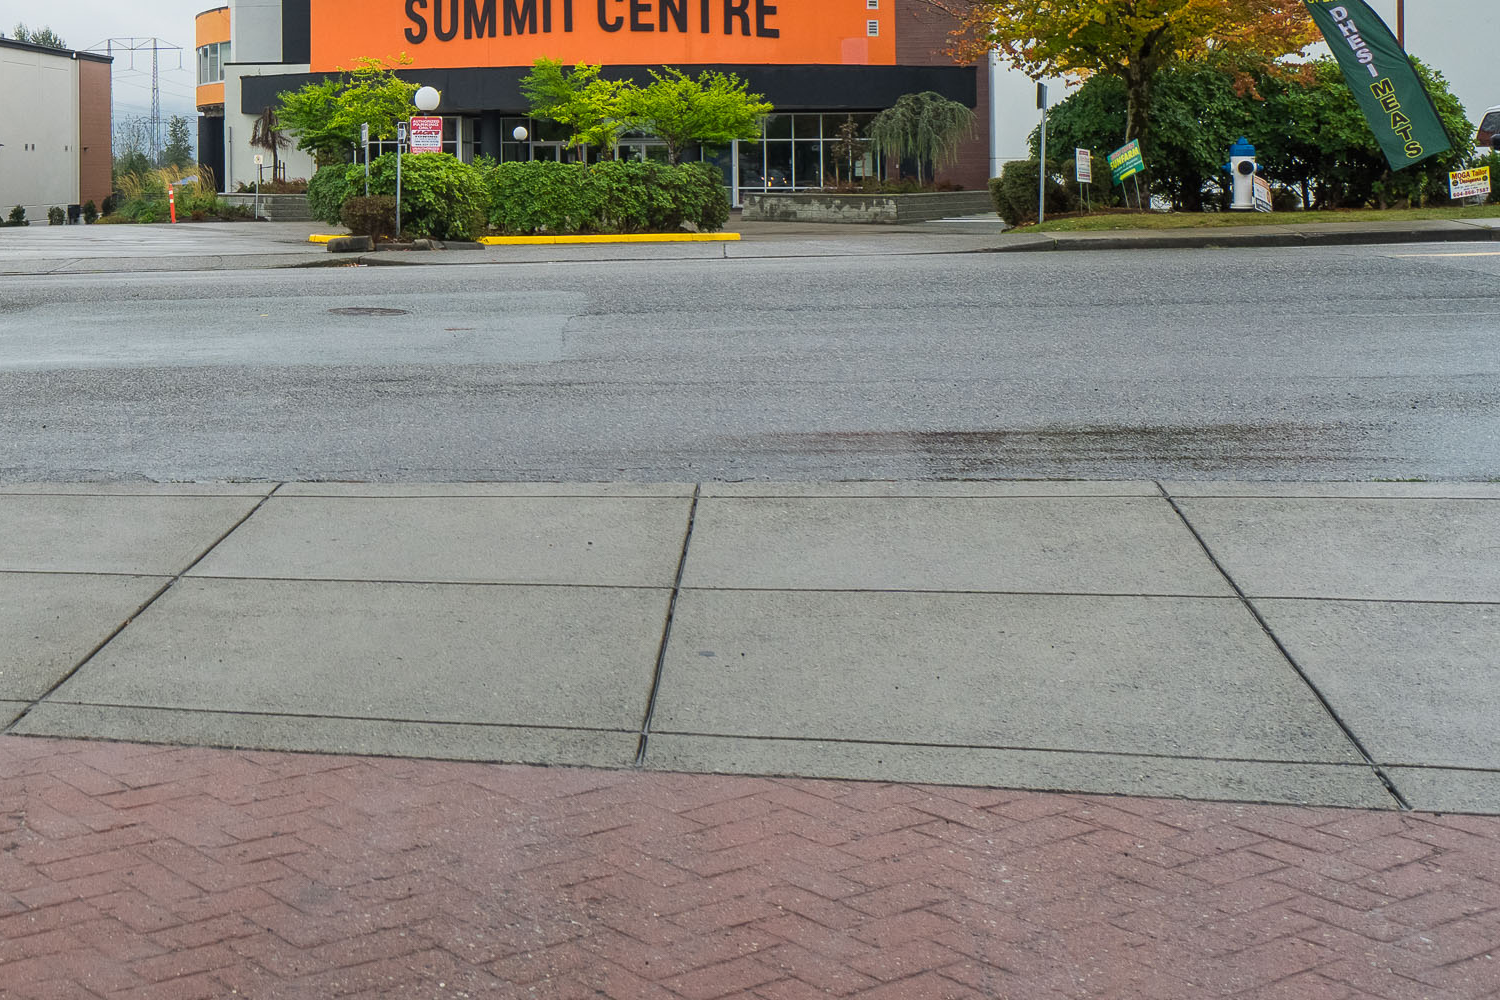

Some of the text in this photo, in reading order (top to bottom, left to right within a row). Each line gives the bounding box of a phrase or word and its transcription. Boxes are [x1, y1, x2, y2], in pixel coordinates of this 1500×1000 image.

[1329, 6, 1423, 158] DHESI MEATS
[1110, 146, 1140, 170] SUNFARM
[1451, 171, 1471, 180] MOGA
